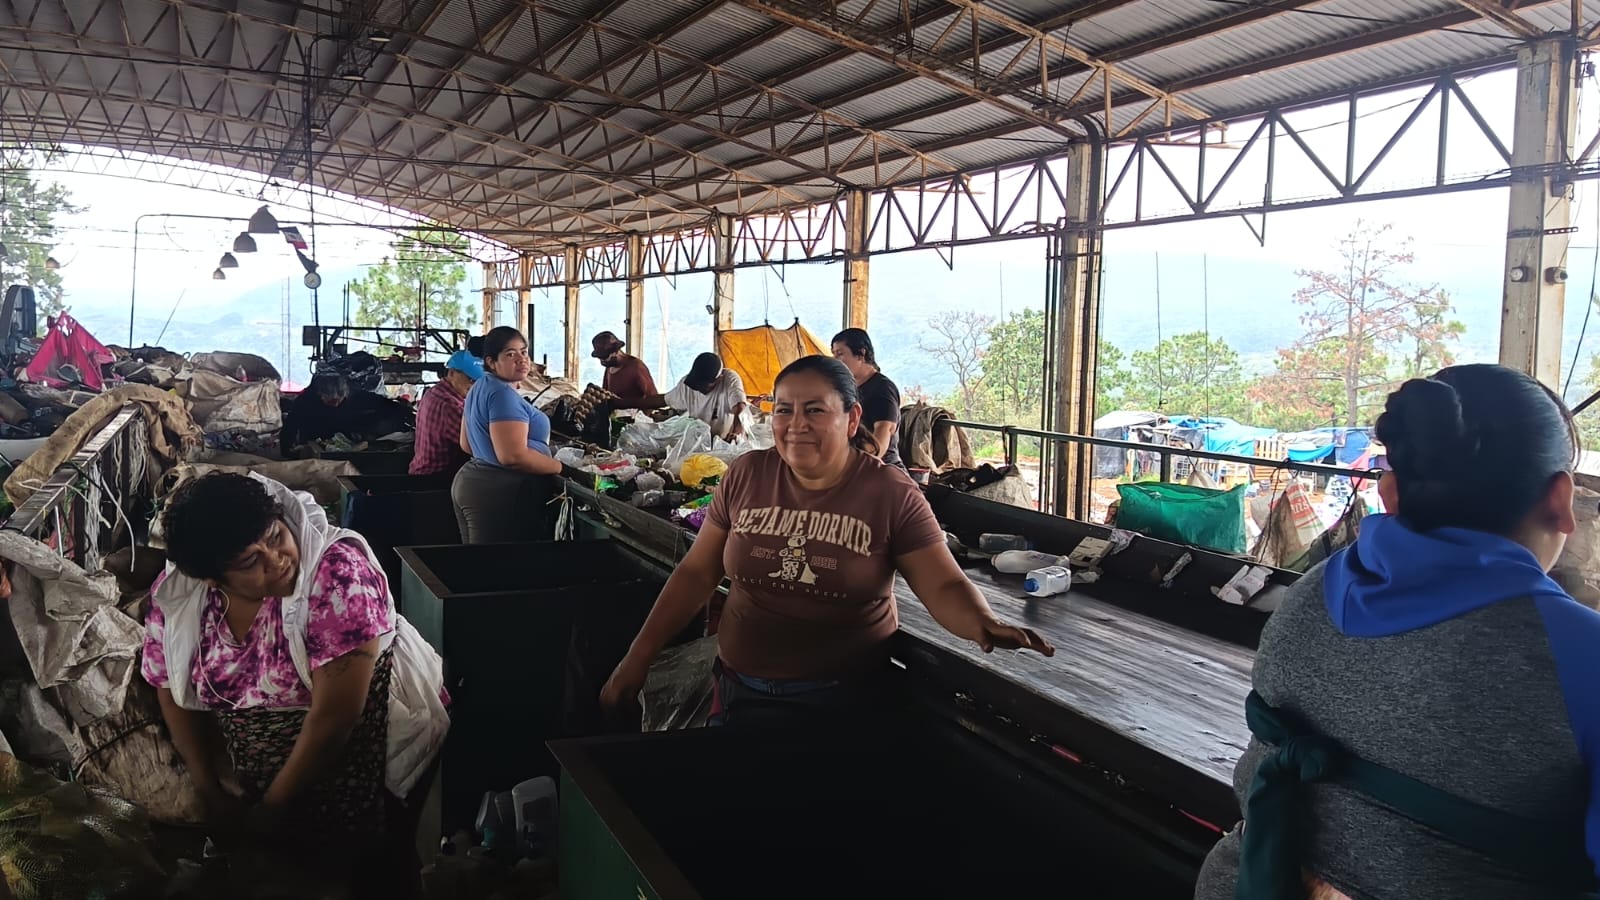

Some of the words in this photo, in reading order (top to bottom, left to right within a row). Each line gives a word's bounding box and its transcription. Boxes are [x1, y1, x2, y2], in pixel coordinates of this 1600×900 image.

[733, 506, 808, 536] DEJAME
[807, 511, 871, 557] DORMIR
[750, 545, 776, 560] EST.
